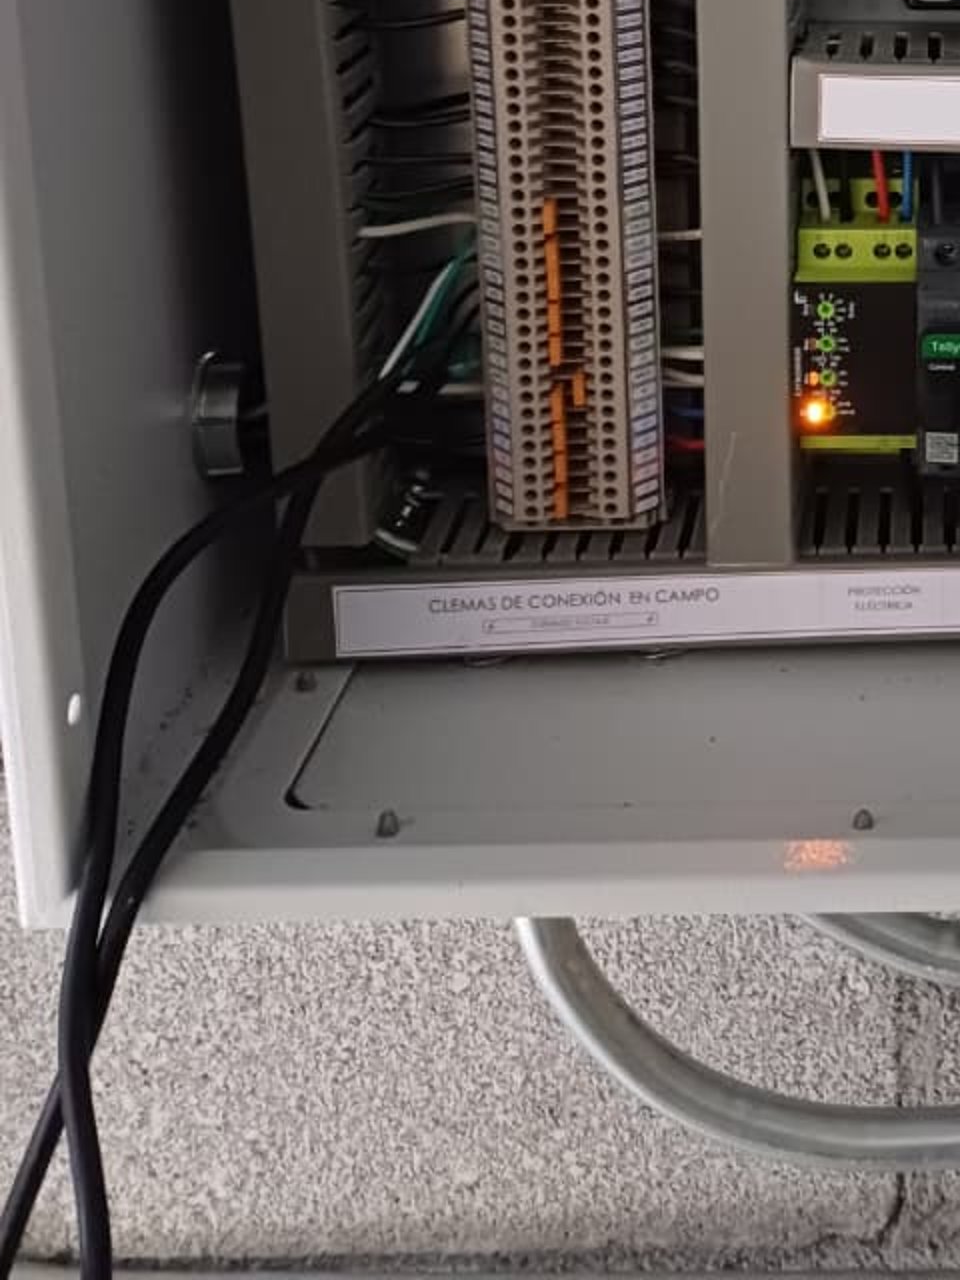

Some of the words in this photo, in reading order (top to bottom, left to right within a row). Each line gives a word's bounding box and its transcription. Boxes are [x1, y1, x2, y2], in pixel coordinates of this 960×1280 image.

[429, 596, 497, 613] CLEMAS
[501, 595, 522, 610] DE
[528, 590, 621, 609] CONEXIÓN
[629, 592, 649, 605] EN
[655, 587, 720, 603] CAMPO
